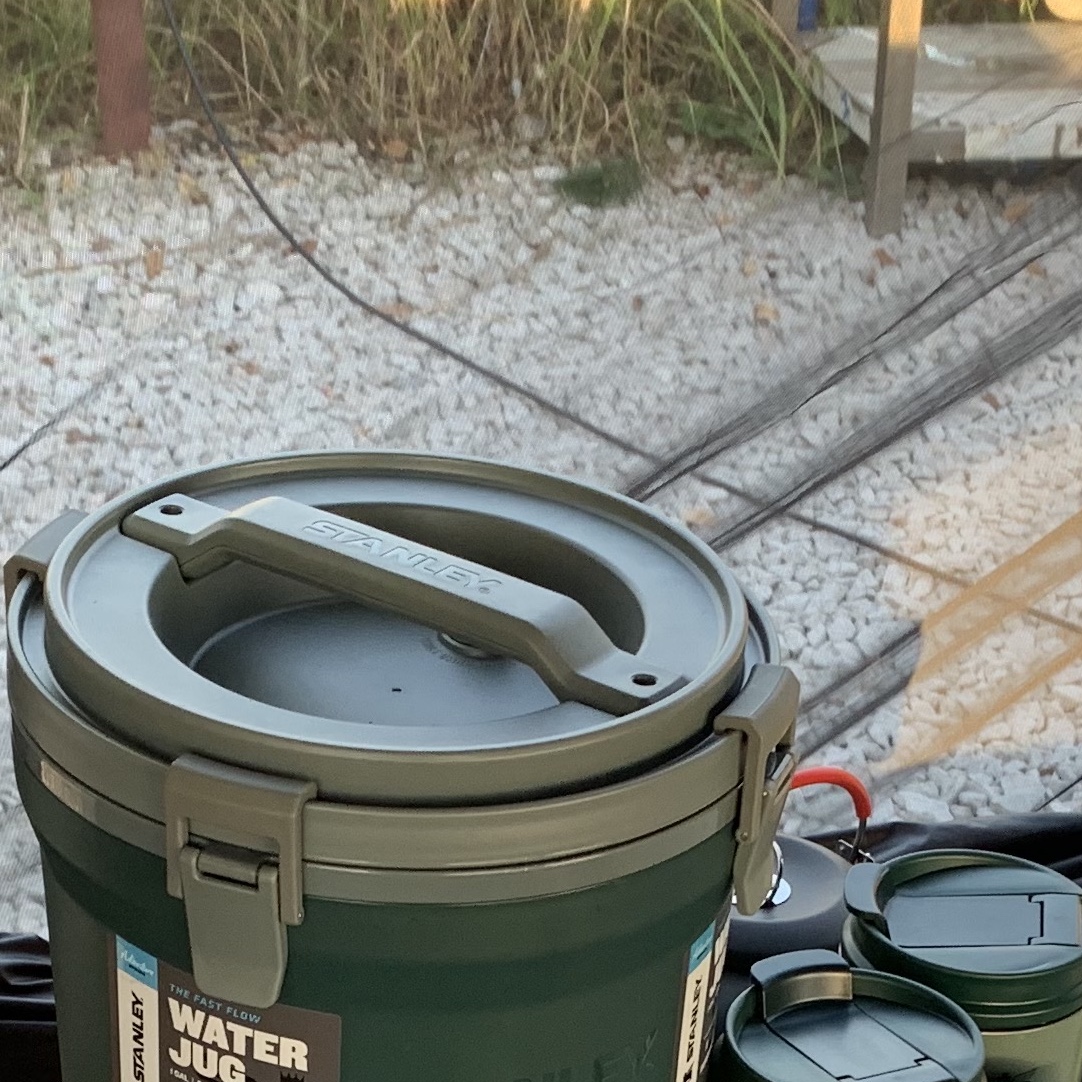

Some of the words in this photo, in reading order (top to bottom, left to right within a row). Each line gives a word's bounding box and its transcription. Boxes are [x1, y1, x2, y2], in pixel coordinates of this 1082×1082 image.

[302, 519, 502, 590] STANLEY
[168, 997, 308, 1072] WATER
[169, 983, 189, 1001] THE
[193, 994, 222, 1015] FAST
[226, 1006, 261, 1024] FLOW
